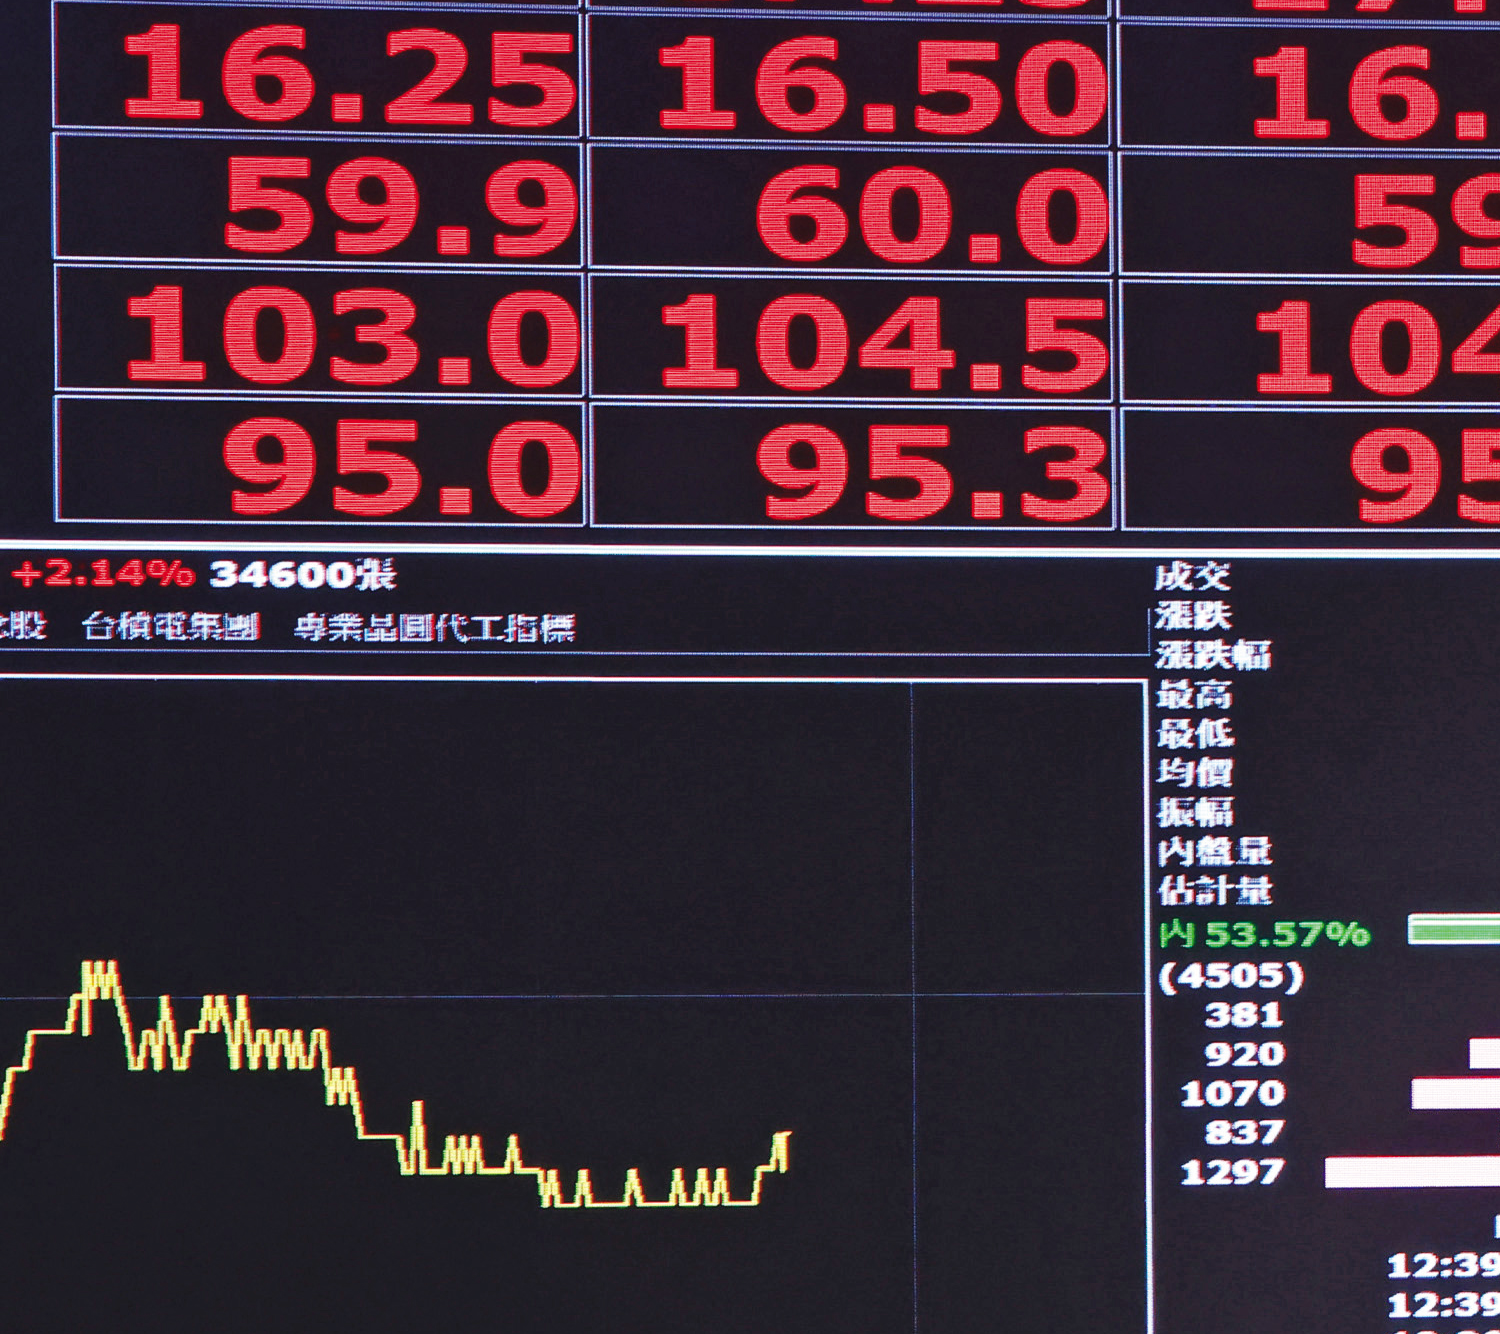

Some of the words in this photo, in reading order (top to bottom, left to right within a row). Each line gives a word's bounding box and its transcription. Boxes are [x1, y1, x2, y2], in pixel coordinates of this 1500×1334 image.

[125, 24, 576, 126] 16.25
[659, 36, 1108, 136] 16.50
[223, 417, 581, 517] 95.0
[756, 424, 1110, 521] 95.3
[12, 559, 196, 587] +2.14%
[211, 558, 396, 590] 34600張
[1155, 561, 1230, 590] 成交
[1155, 601, 1232, 630] 漲跌
[1157, 679, 1232, 708] 最高
[1206, 921, 1371, 947] 53.57%
[1160, 962, 1303, 995] (4505)
[1206, 1002, 1283, 1027] 381
[1182, 1080, 1285, 1106] 1070
[1182, 1159, 1284, 1185] 1297
